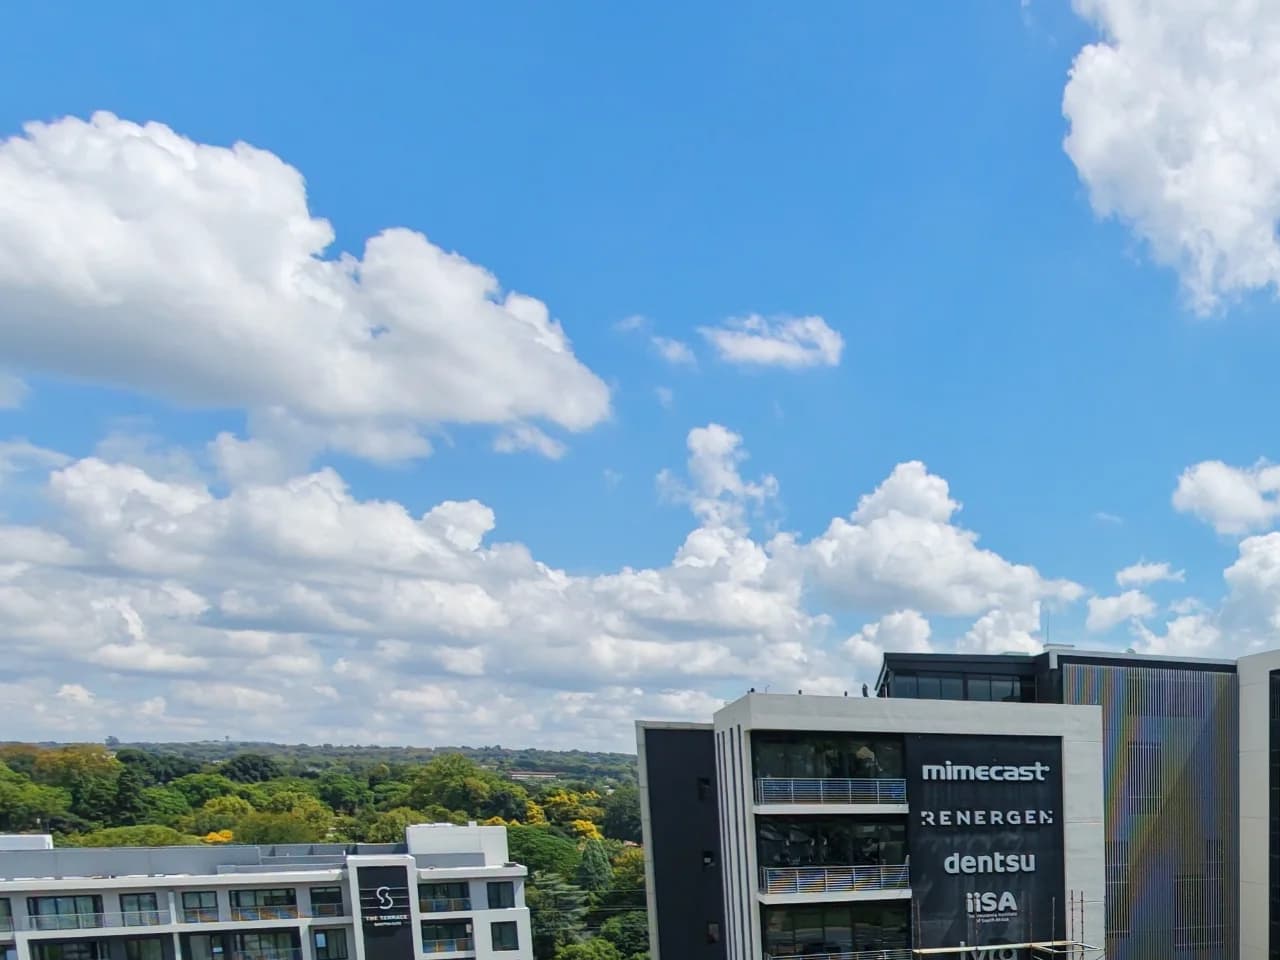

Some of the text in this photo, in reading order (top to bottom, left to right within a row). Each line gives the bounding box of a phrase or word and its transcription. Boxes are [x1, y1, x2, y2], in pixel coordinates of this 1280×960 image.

[922, 760, 1050, 781] mimecast
[920, 810, 1053, 826] RENERGEN
[944, 852, 1036, 874] dentsu
